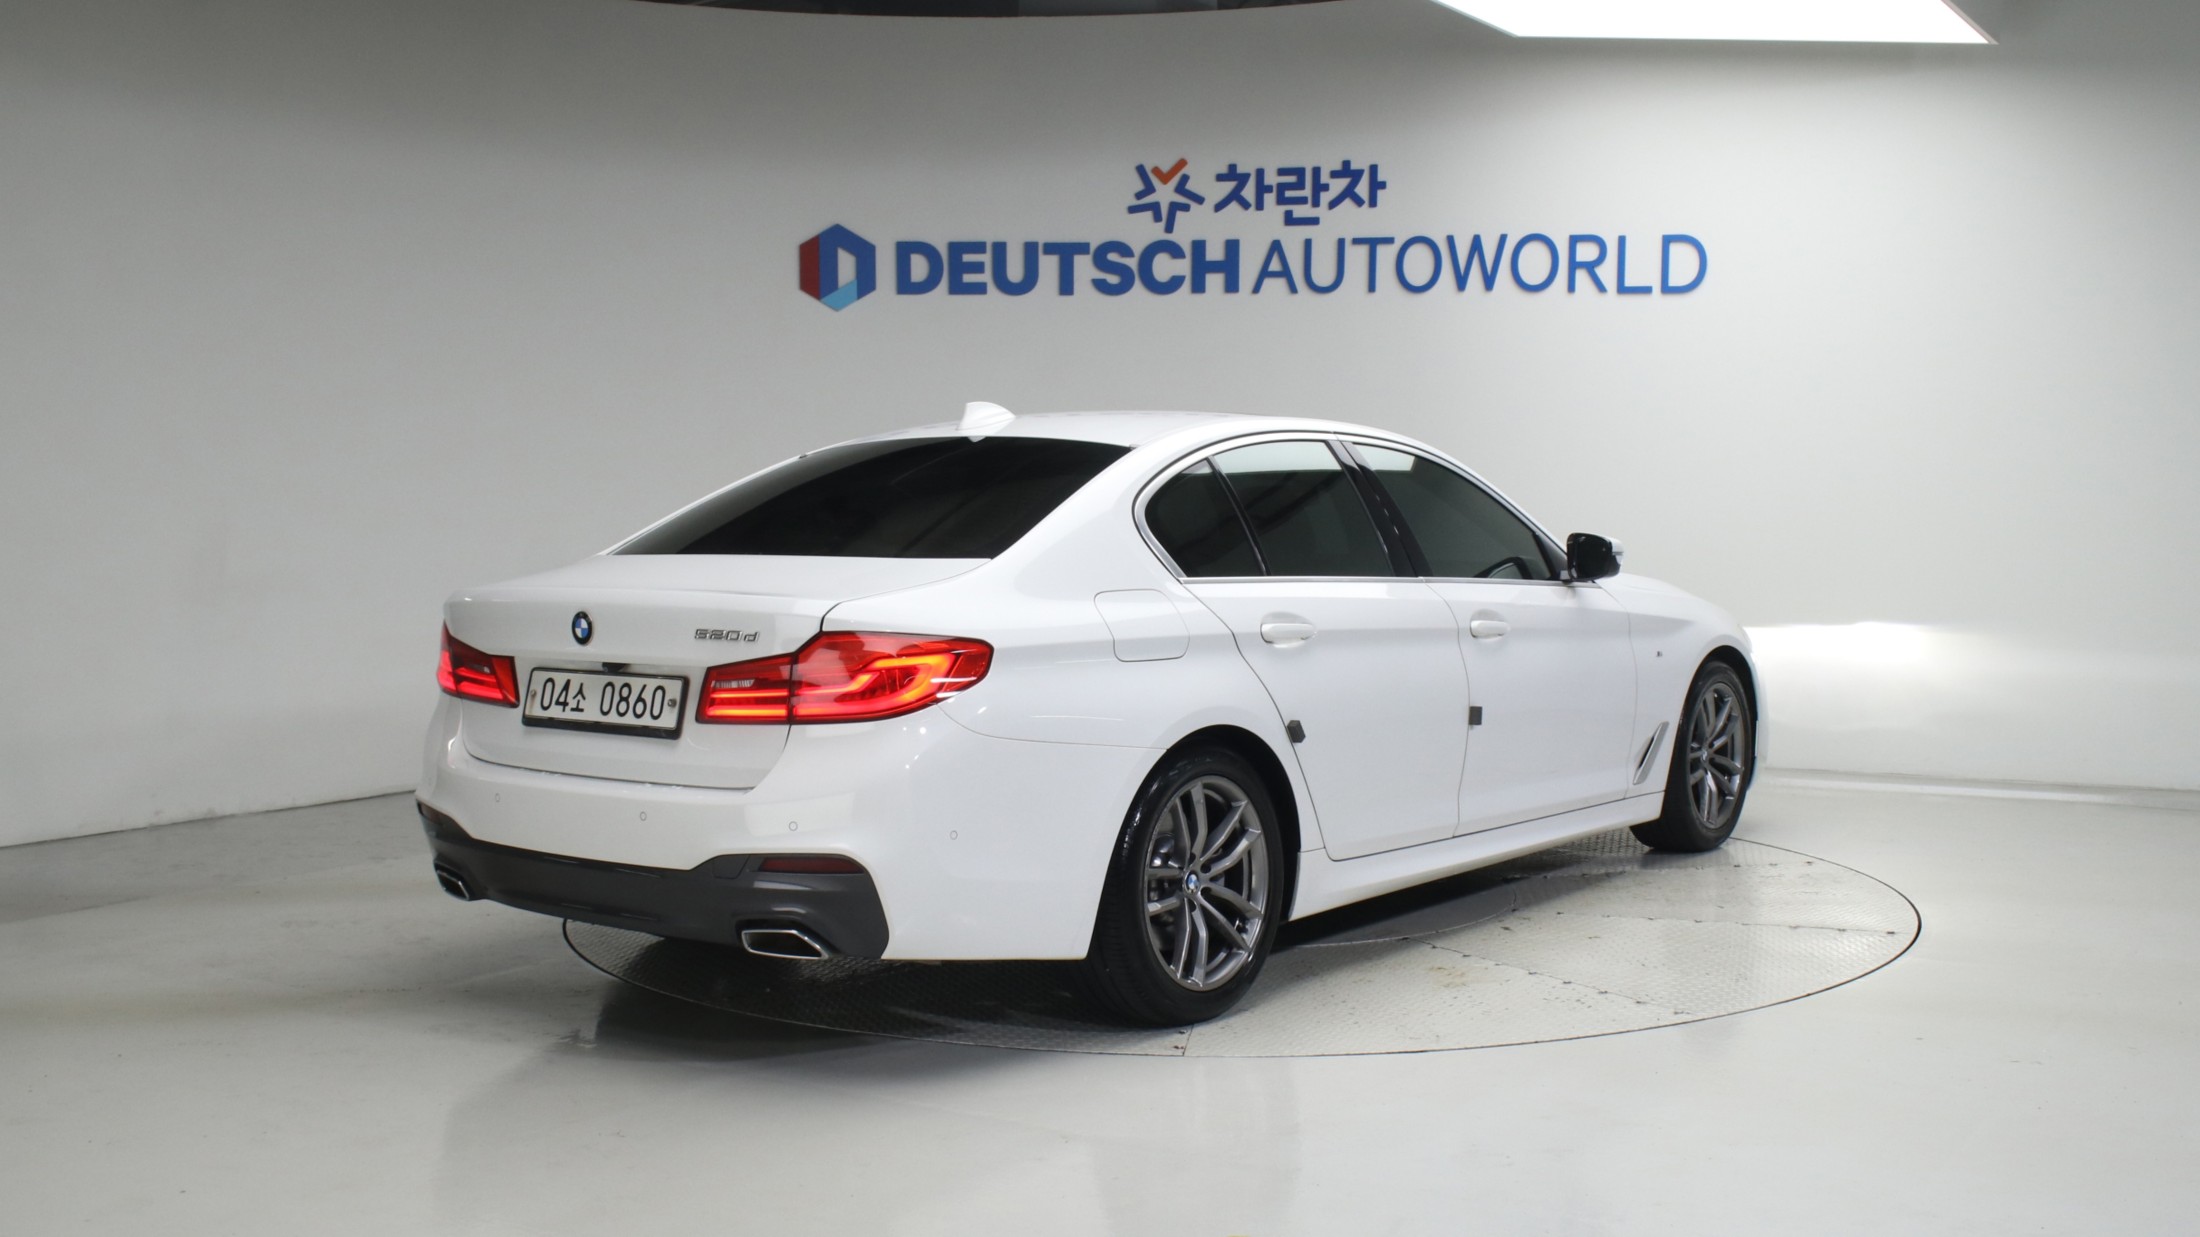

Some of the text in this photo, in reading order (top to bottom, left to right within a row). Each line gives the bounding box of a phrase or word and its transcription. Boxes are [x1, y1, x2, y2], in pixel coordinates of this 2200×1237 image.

[1214, 160, 1387, 226] 차란차
[896, 233, 1708, 296] DEUTSCH AUTOWORLD
[695, 628, 759, 642] 520d
[540, 677, 666, 720] 04소 0860
